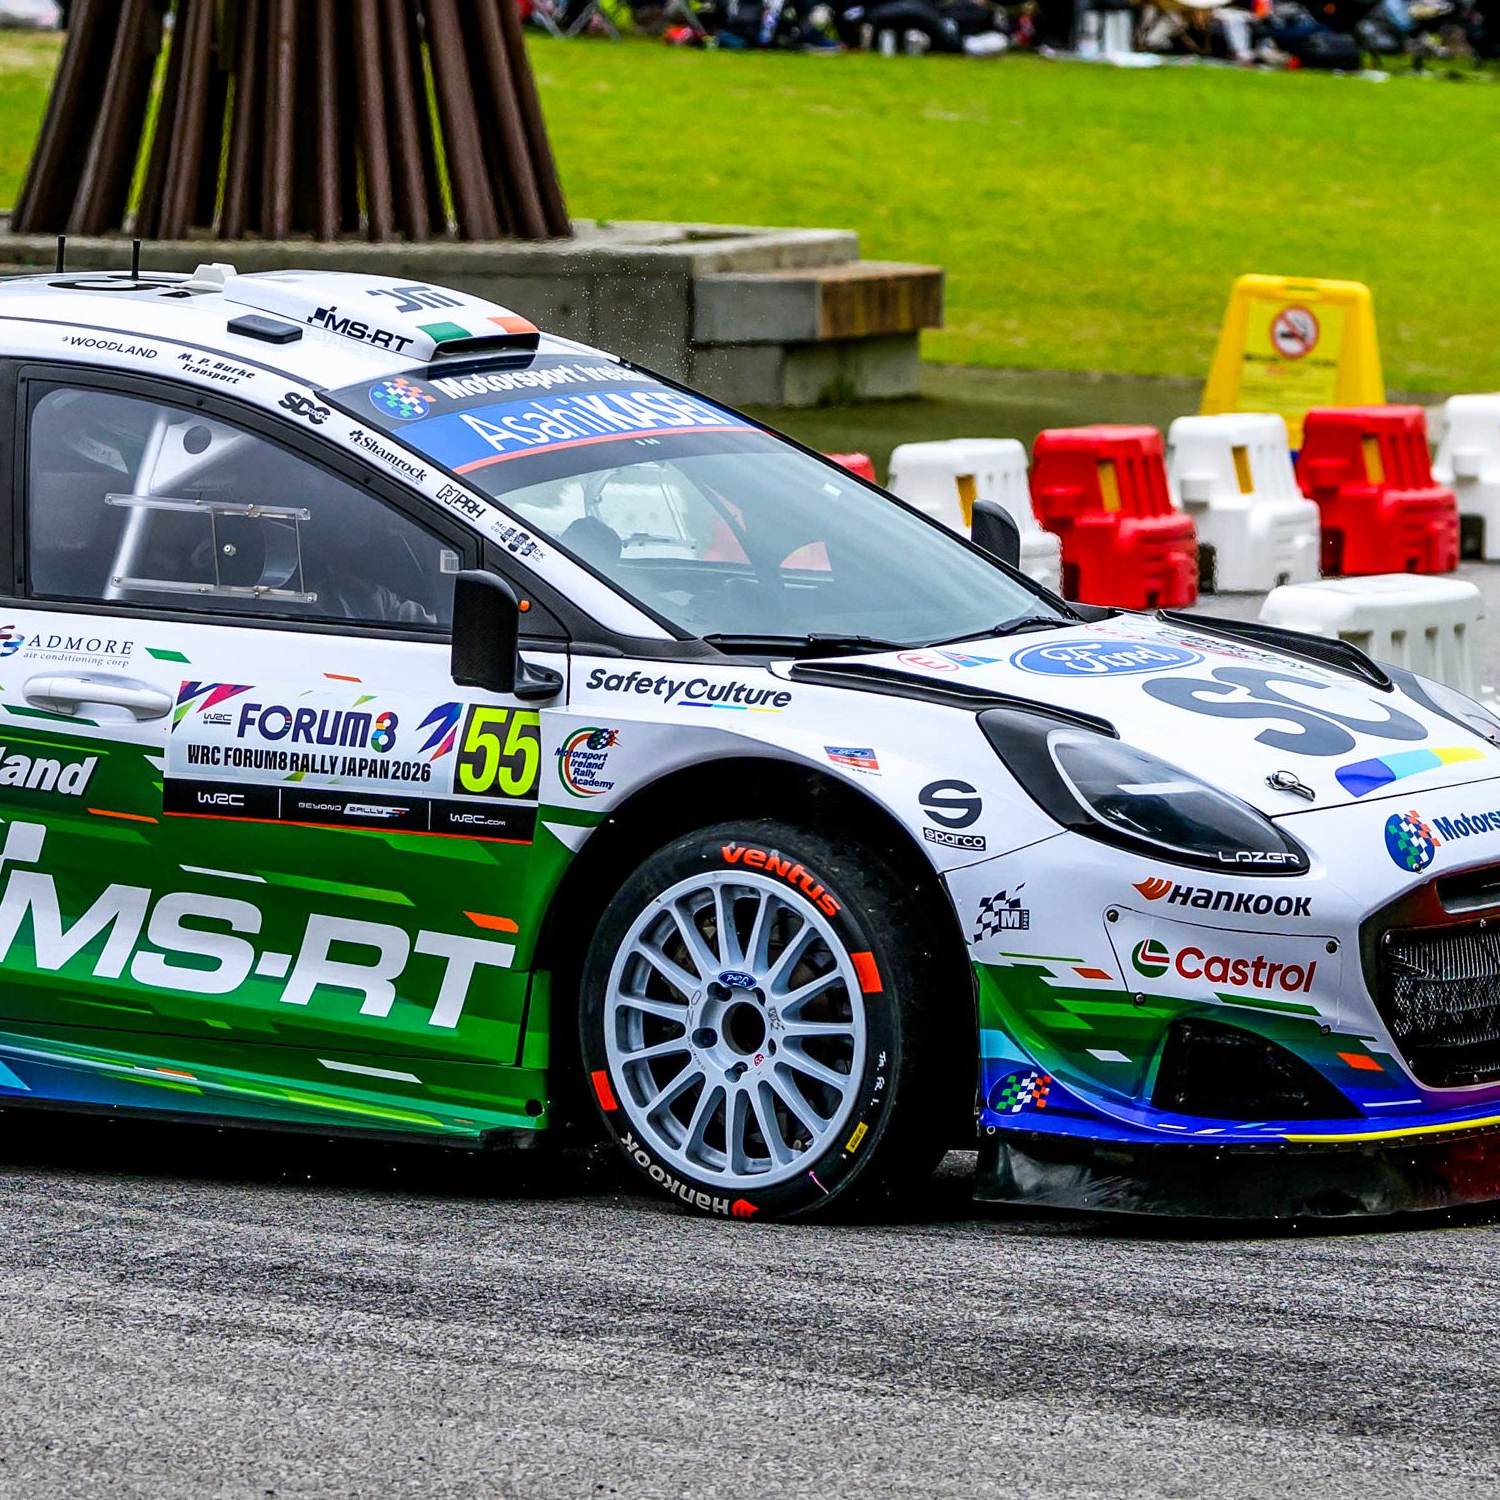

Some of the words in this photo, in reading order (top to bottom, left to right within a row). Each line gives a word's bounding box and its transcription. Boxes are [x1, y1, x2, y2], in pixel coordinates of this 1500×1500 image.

[324, 313, 414, 352] MS-RT
[69, 336, 158, 360] WOODLAND
[177, 352, 194, 364] M.
[198, 357, 212, 367] P.
[213, 361, 255, 380] Burke
[182, 363, 240, 385] Transport
[429, 363, 578, 401] Motorsport
[278, 391, 331, 424] SDC
[458, 390, 733, 452] AsahiKASEI
[360, 437, 428, 482] Shamrock
[454, 494, 487, 518] PRH
[27, 634, 134, 655] ADMORE
[23, 652, 38, 660] air
[40, 653, 104, 666] conditioning
[106, 659, 130, 668] corp
[1040, 643, 1182, 674] Ford
[585, 668, 792, 708] SafetyCulture
[203, 712, 233, 721] WRC
[237, 702, 397, 754] FORUM8
[187, 744, 221, 765] WRC
[224, 747, 288, 771] FORUM8
[289, 751, 338, 775] RALLY
[340, 757, 390, 779] JAPAN
[391, 760, 432, 783] 2026
[458, 707, 542, 797] 55
[554, 747, 608, 761] Motorsport
[570, 759, 605, 770] Ireland
[573, 767, 597, 779] Rally
[571, 776, 615, 790] Academy
[197, 791, 245, 806] WRC
[298, 801, 342, 812] BEYOND
[924, 828, 985, 849] sparco
[1217, 851, 1301, 865] LAZER
[1175, 947, 1317, 993] Castrol
